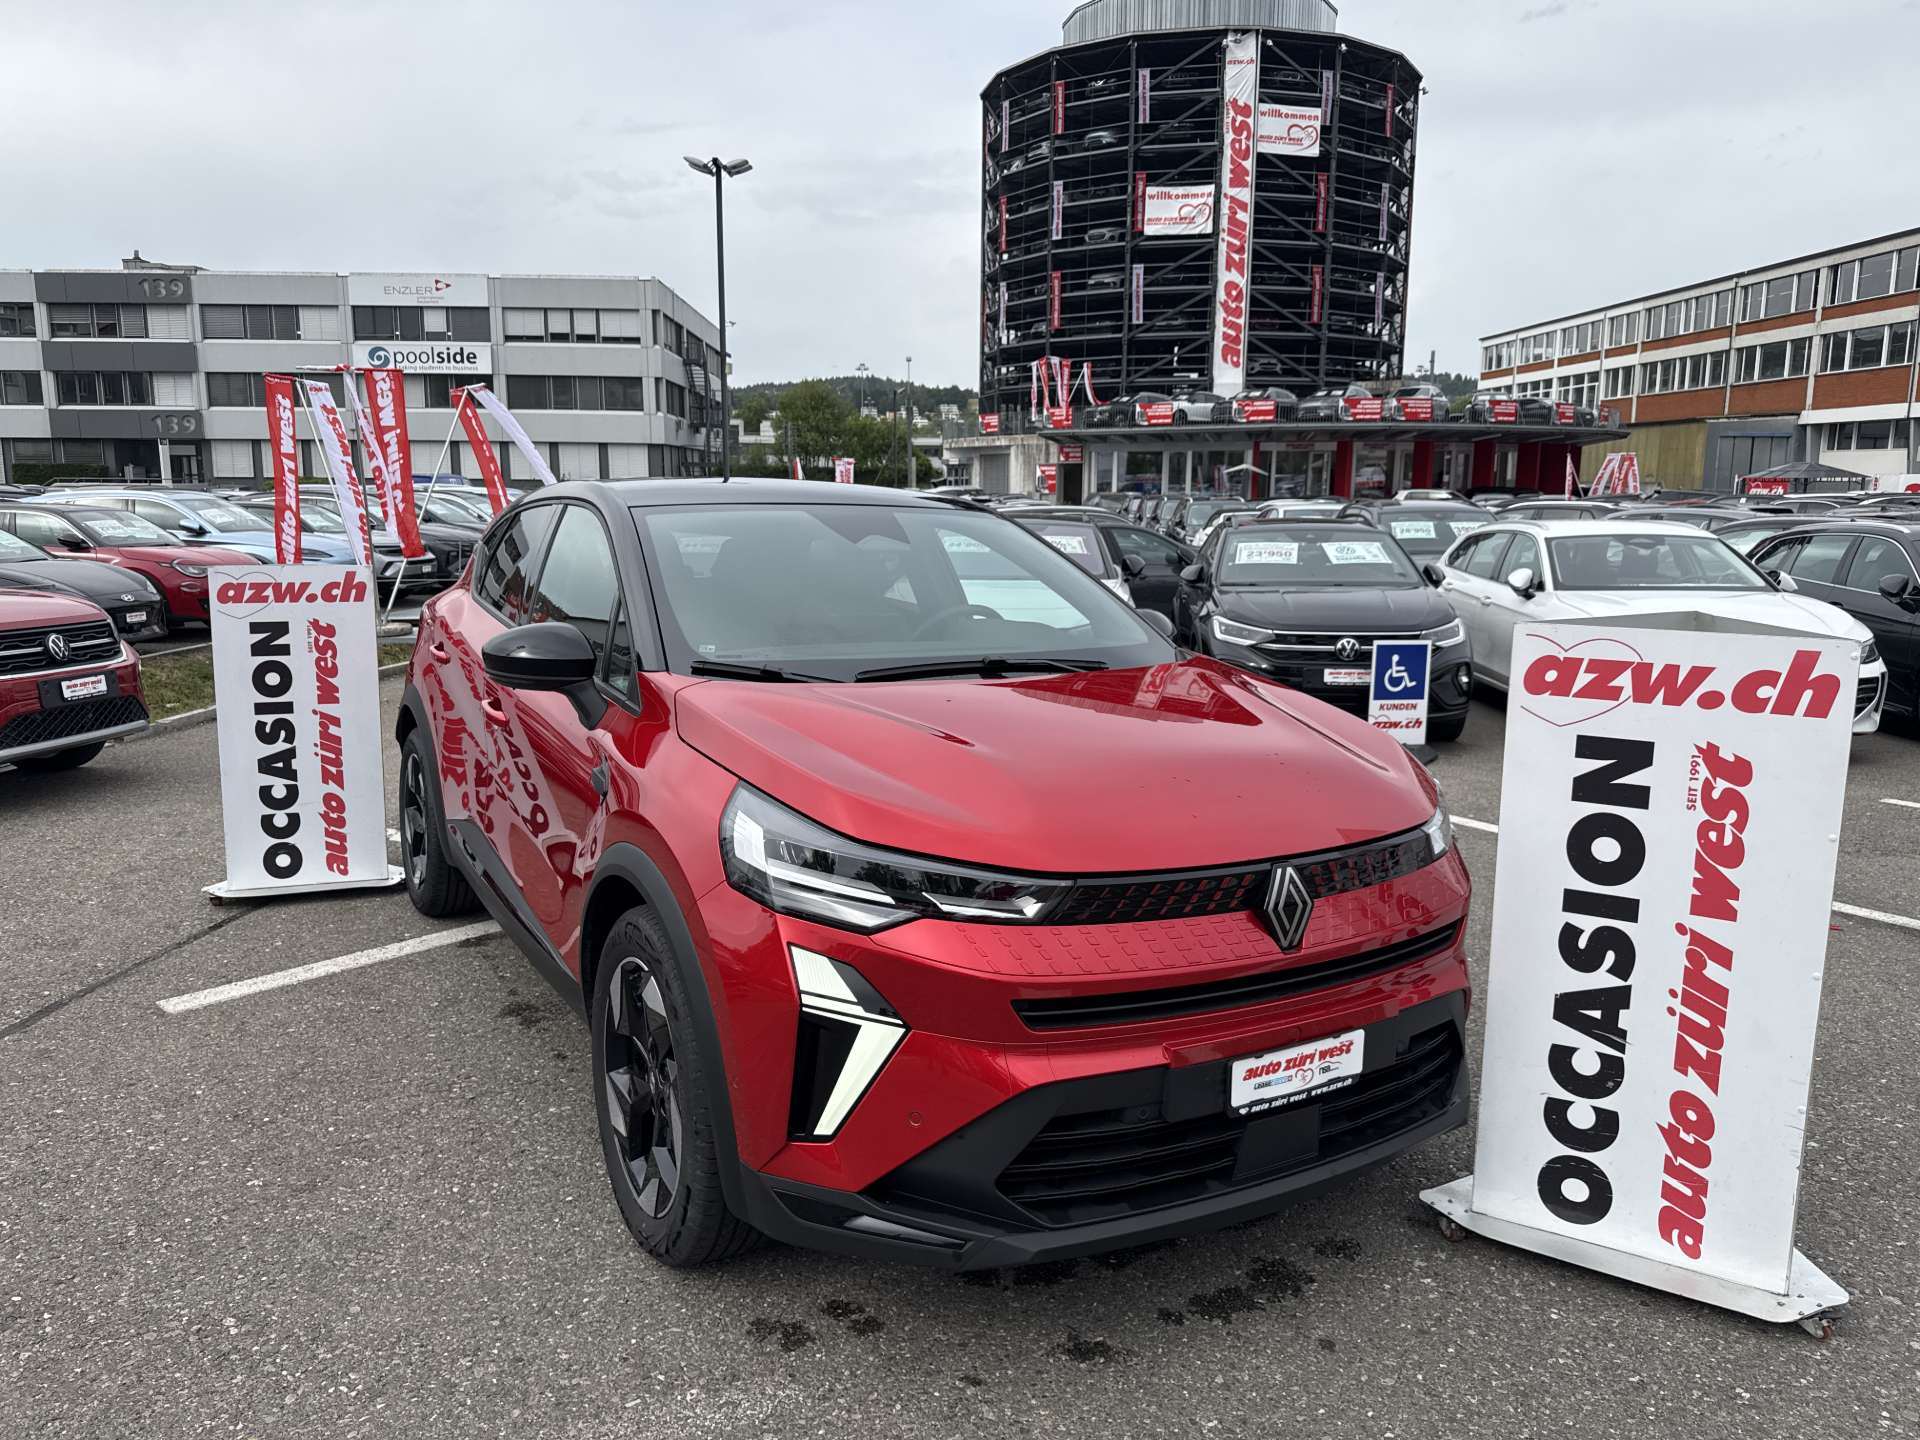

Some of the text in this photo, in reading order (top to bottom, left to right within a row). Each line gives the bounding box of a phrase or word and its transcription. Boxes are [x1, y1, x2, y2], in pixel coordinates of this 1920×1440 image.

[1259, 108, 1319, 122] willkommen
[1147, 190, 1213, 201] willkommen
[1220, 97, 1253, 369] auto züri west
[138, 278, 184, 298] 139
[384, 286, 433, 295] ENZLER
[393, 346, 478, 370] poolside
[151, 414, 197, 434] 139
[275, 393, 295, 454] west
[216, 571, 367, 604] azw.ch
[1523, 649, 1841, 720] azw.ch
[1378, 703, 1418, 711] KUNDEN
[249, 621, 303, 879] OCCASION
[309, 618, 350, 877] auto züri west
[1686, 754, 1702, 811] SEIT 1991
[1537, 734, 1655, 1226] OCCASION
[1656, 740, 1754, 1260] auto züri west
[1243, 1060, 1282, 1081] auto
[1283, 1048, 1318, 1072] züri
[1318, 1040, 1354, 1062] west
[1250, 1102, 1270, 1113] auto
[1289, 1091, 1308, 1103] west
